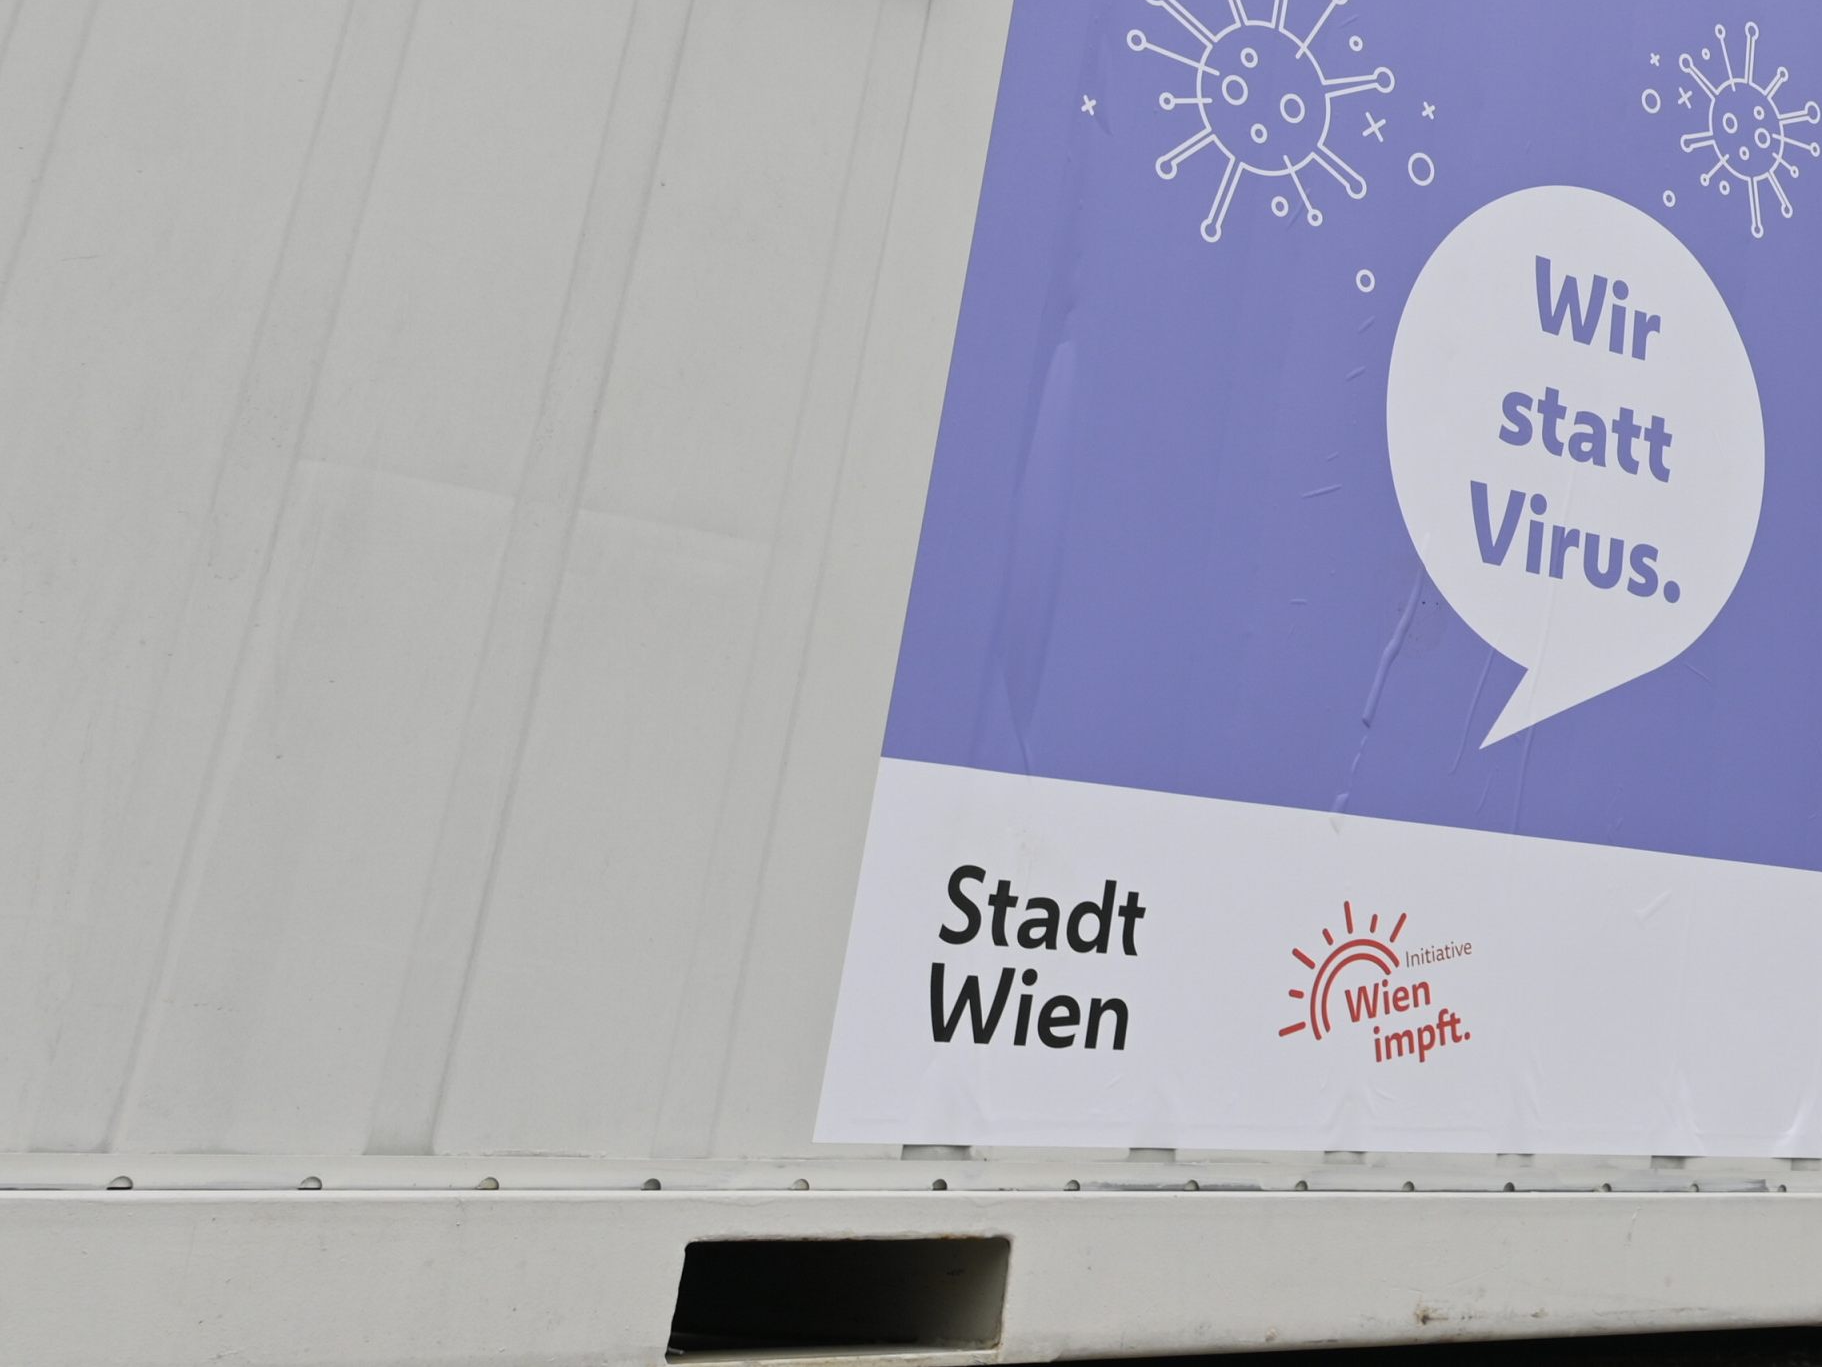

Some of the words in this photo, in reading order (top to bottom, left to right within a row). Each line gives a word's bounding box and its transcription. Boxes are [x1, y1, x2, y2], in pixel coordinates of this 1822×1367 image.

[1534, 254, 1662, 362] Wir
[1498, 386, 1674, 484] statt
[1469, 479, 1682, 605] Virus.
[937, 863, 1147, 957] Stadt
[1404, 940, 1473, 969] Initiative
[929, 961, 1131, 1052] Wien
[1344, 978, 1432, 1024] Wien
[1372, 1007, 1473, 1064] impft.
